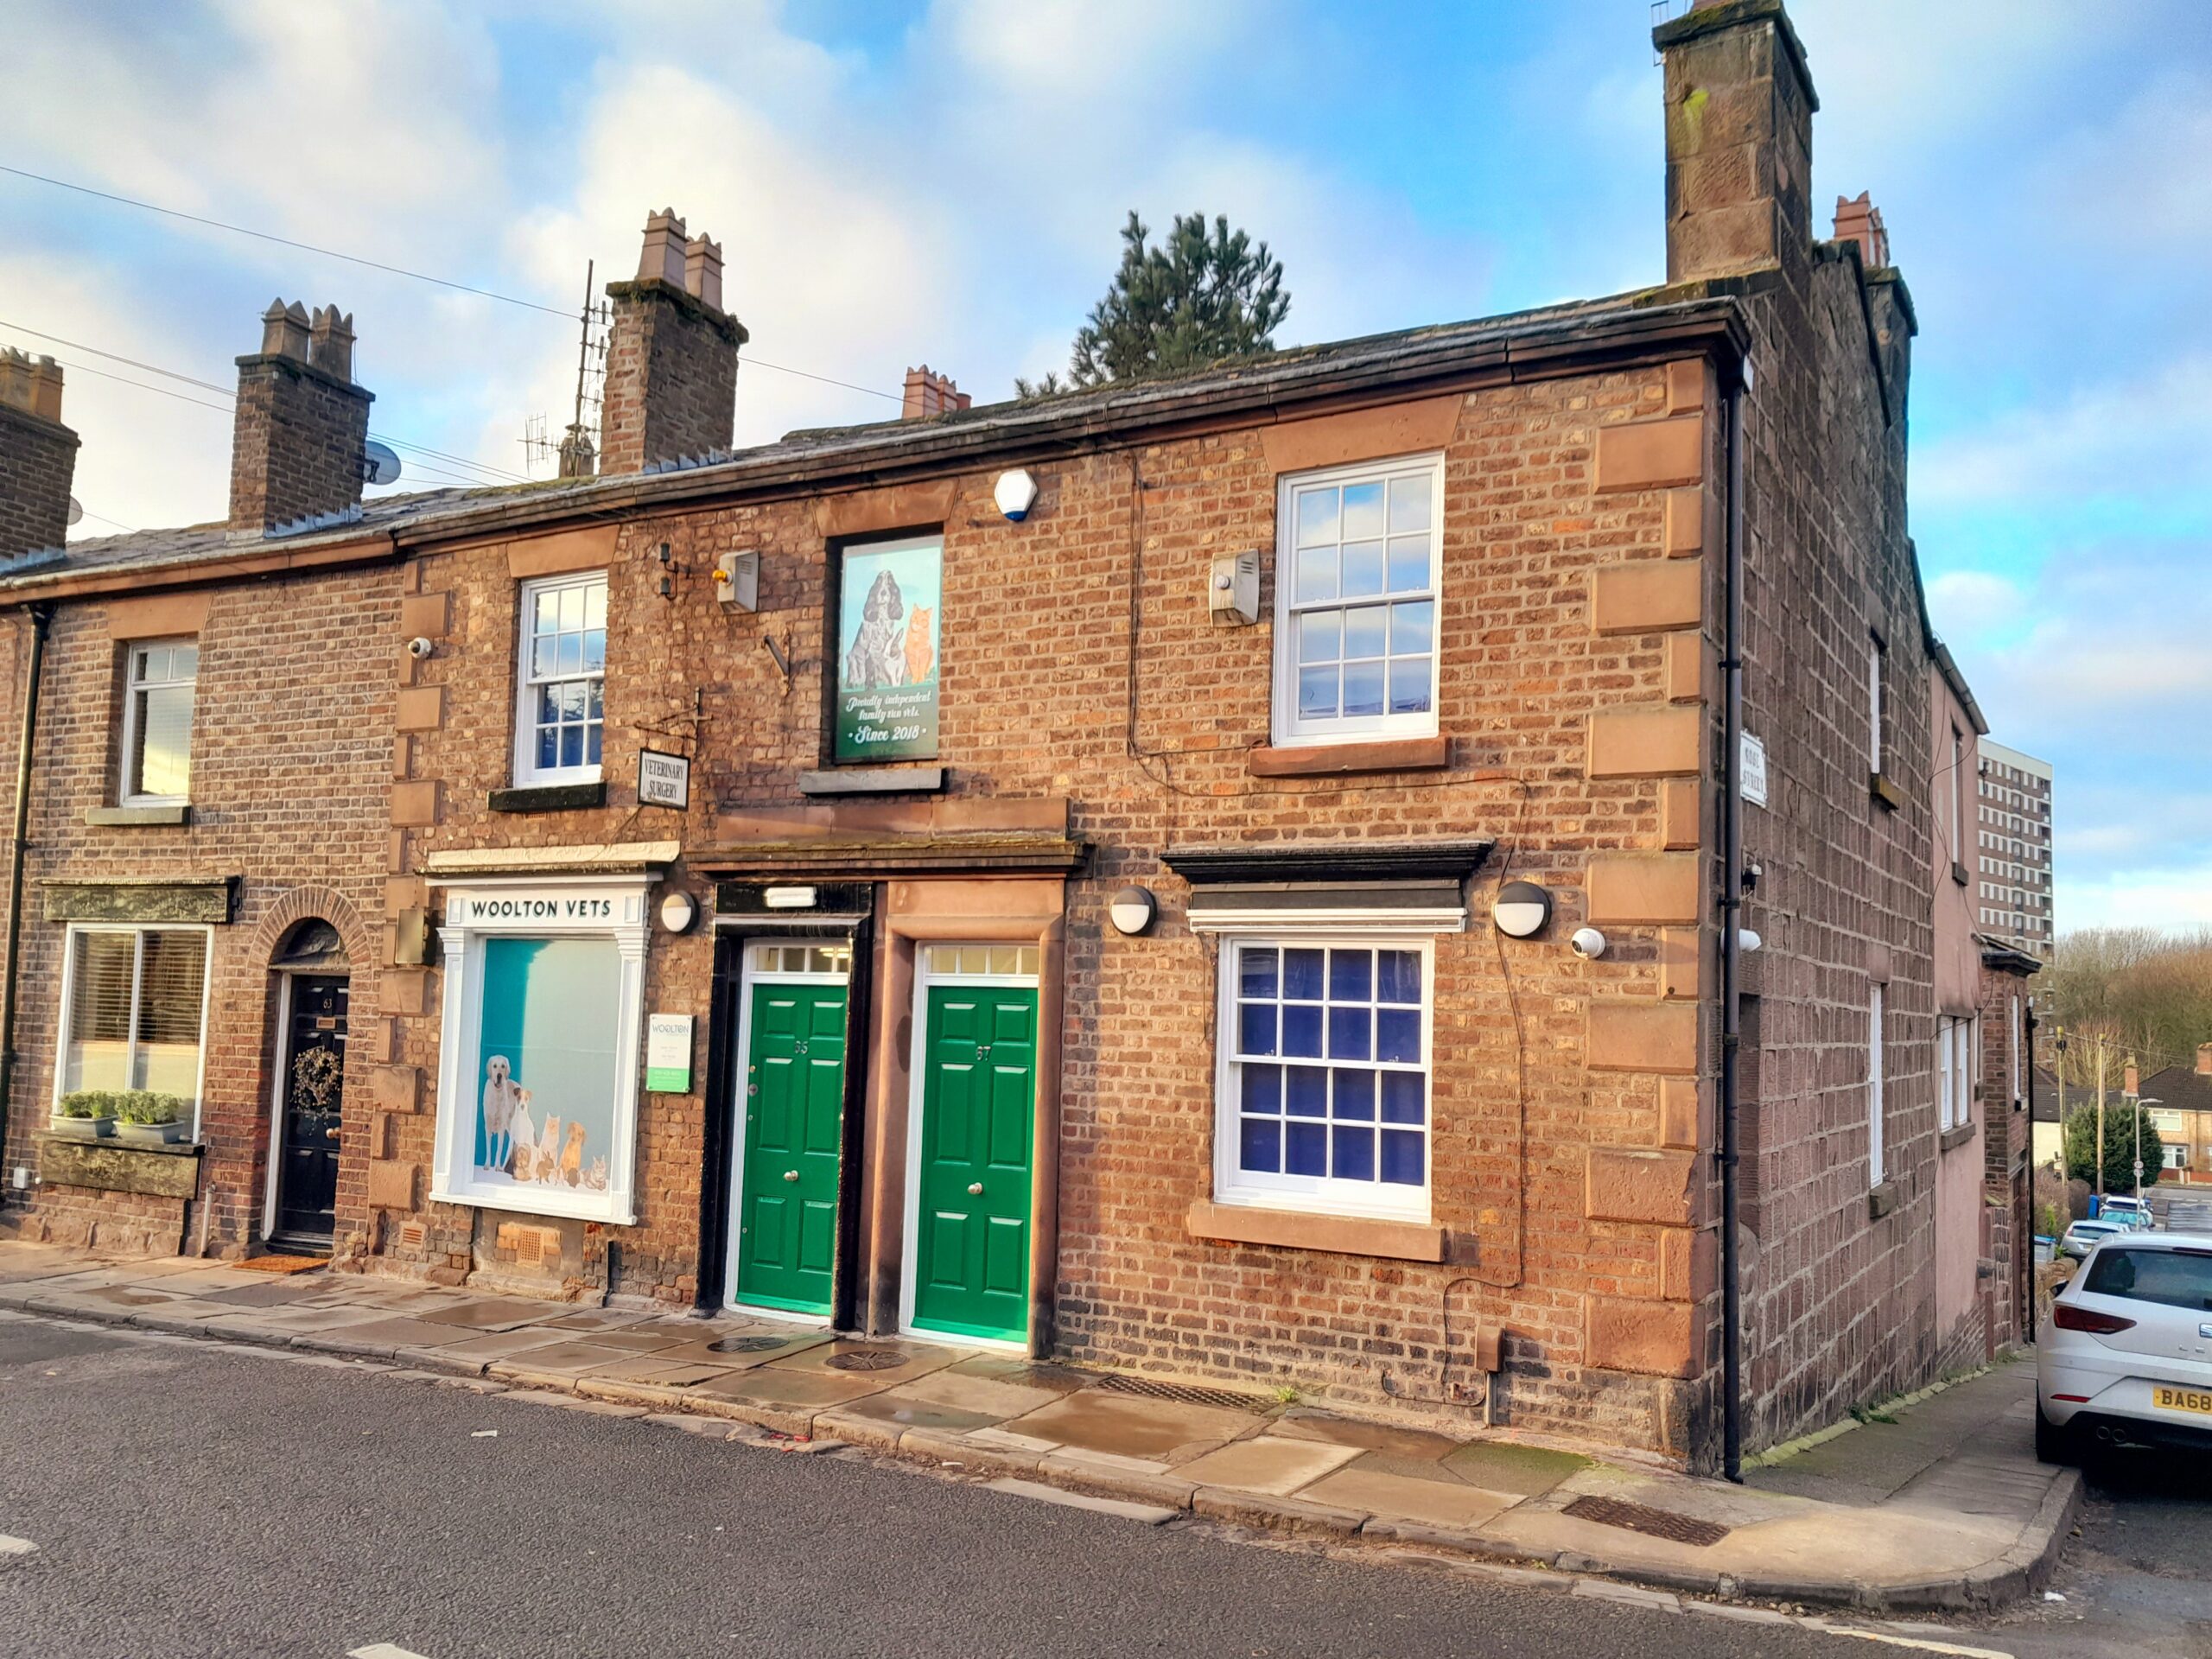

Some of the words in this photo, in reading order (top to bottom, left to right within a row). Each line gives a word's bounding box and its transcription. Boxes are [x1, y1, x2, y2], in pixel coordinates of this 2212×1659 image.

[846, 695, 882, 712] Proudly
[885, 690, 931, 707] independent
[858, 709, 887, 724] family
[887, 709, 901, 719] run
[855, 726, 889, 744] Since
[892, 725, 919, 741] 2018
[645, 758, 684, 780] VETERINARY
[649, 779, 677, 799] SURGERY
[1743, 770, 1764, 794] STREET
[472, 900, 557, 918] WOOLTON
[566, 899, 611, 917] VETS
[652, 1023, 690, 1033] WOOLTON
[2161, 1389, 2211, 1411] BA68
